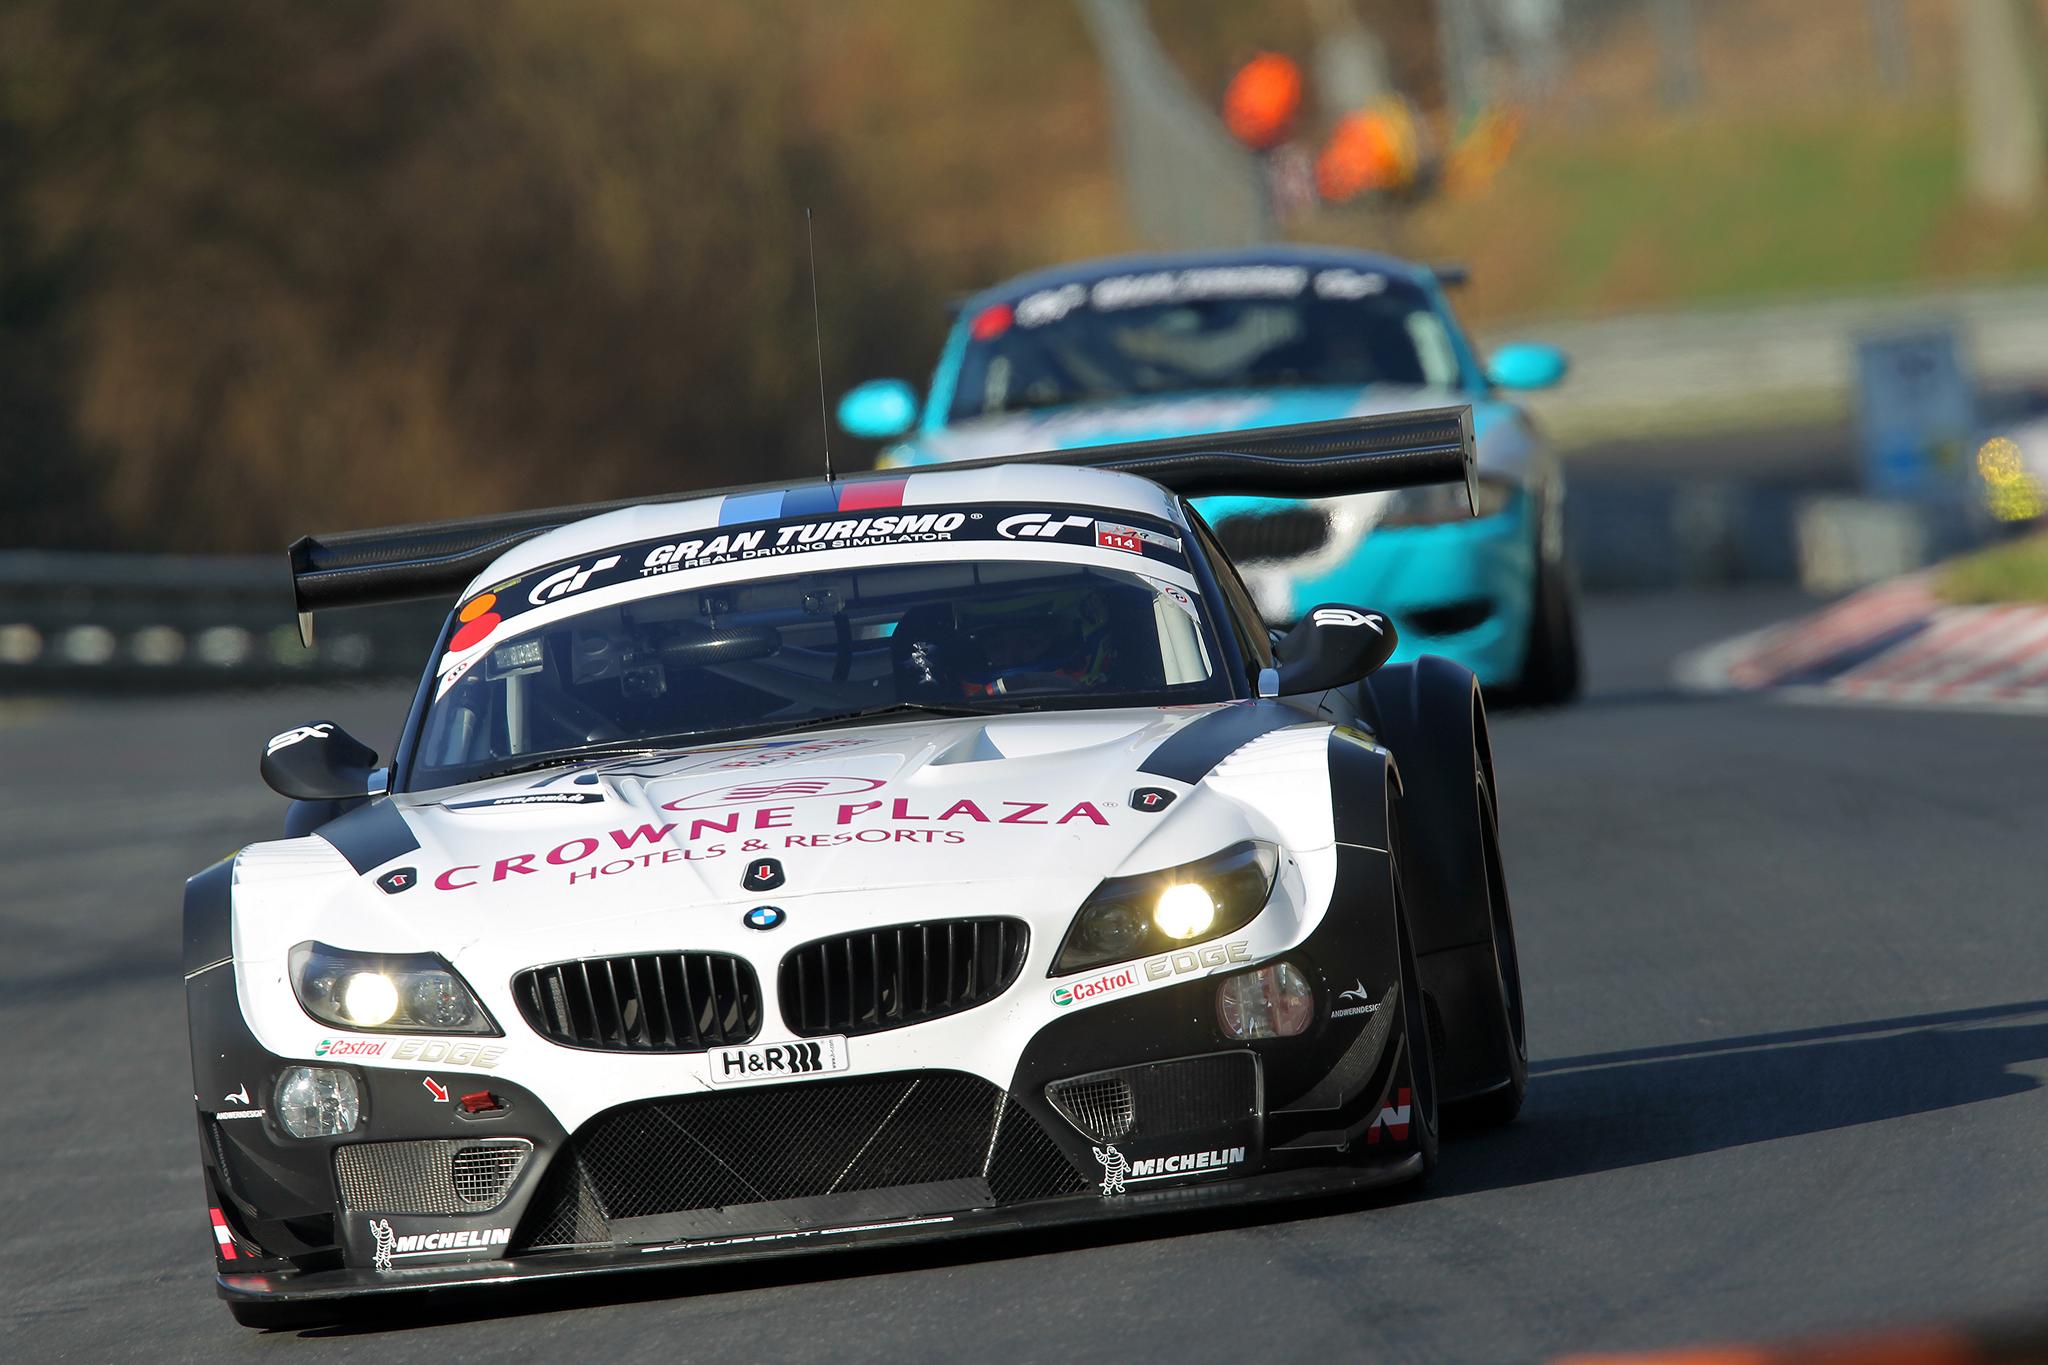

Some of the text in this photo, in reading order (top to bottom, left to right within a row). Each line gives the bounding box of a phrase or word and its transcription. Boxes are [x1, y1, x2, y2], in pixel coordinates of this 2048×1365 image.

[640, 532, 952, 577] THE REAL DRIVING SIMULATOR
[643, 512, 966, 567] GRAN TURISMO
[1104, 535, 1135, 549] 114
[434, 798, 1111, 891] CROWNE PLAZA
[569, 829, 966, 885] HOTELS & RESORTS
[1073, 940, 1254, 1002] Castrol EDGE
[1330, 1003, 1381, 1019] ANDWERNDESIG
[329, 1039, 508, 1069] Castrol EDGE
[722, 1048, 786, 1075] H&R
[1131, 1146, 1246, 1178] MICHELIN
[395, 1227, 512, 1252] MICHELIN
